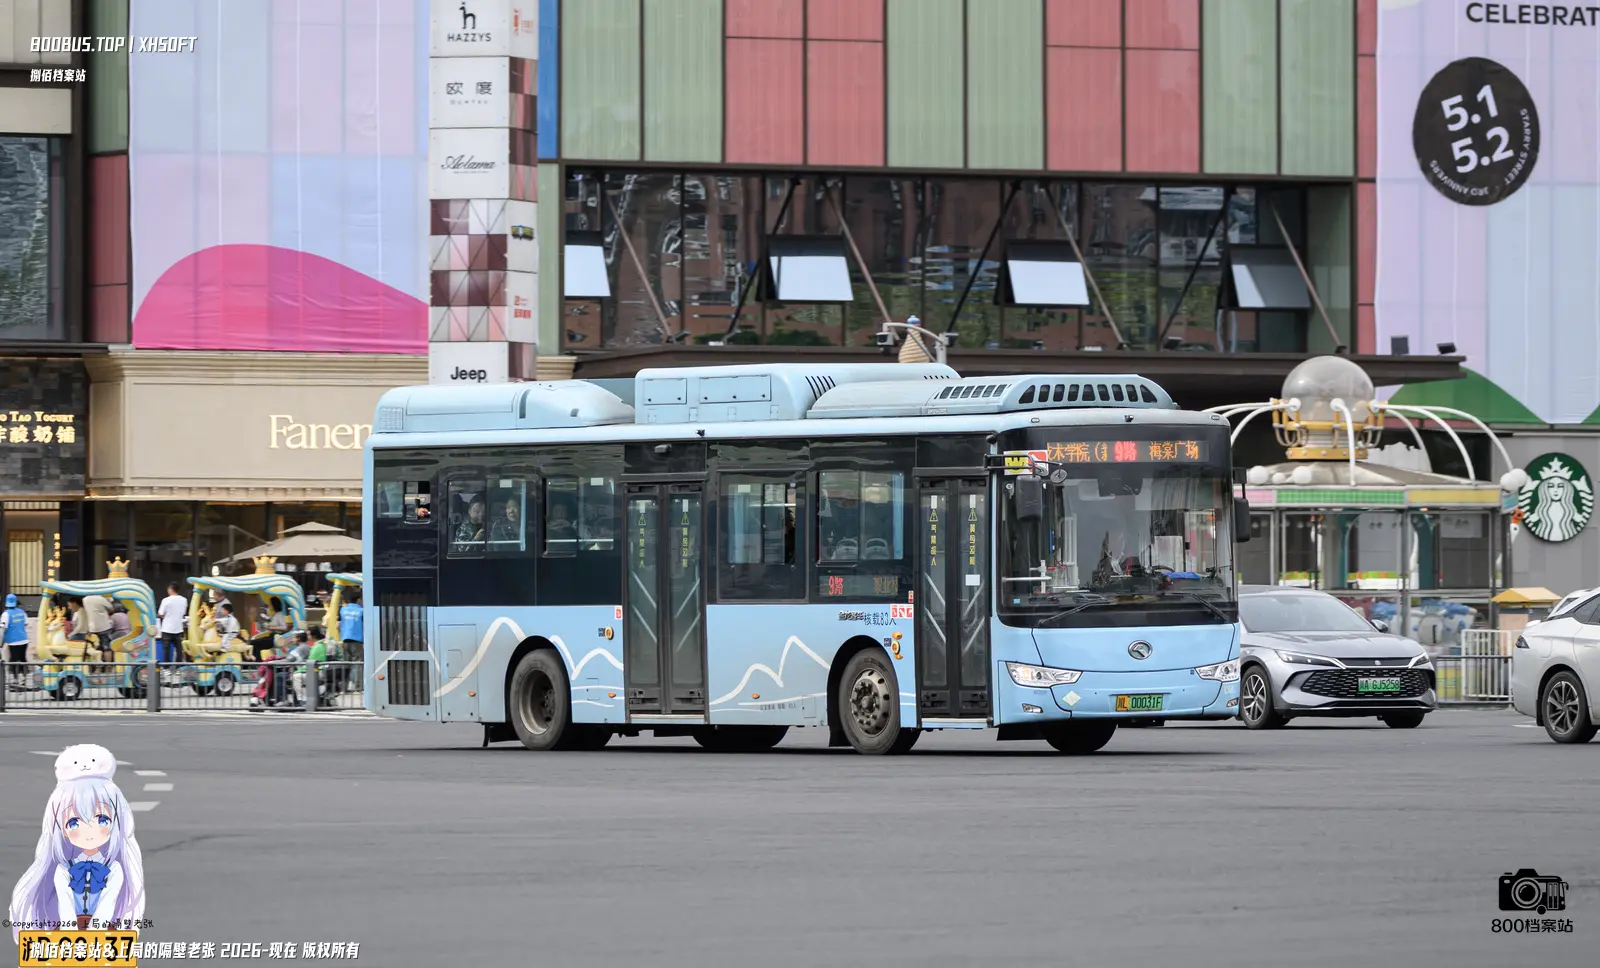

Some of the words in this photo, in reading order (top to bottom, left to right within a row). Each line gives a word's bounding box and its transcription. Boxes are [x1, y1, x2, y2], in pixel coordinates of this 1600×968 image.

[1466, 2, 1600, 26] CELEBRAT
[447, 33, 492, 42] HAZZYS
[1441, 84, 1498, 132] 5.1
[1520, 108, 1532, 150] STARRY
[1451, 126, 1514, 174] 5.2
[1504, 151, 1528, 185] STREET
[450, 366, 487, 383] Jeep
[1114, 440, 1137, 462] 9路
[1148, 440, 1199, 461] 海棠广场
[828, 575, 844, 596] 9路
